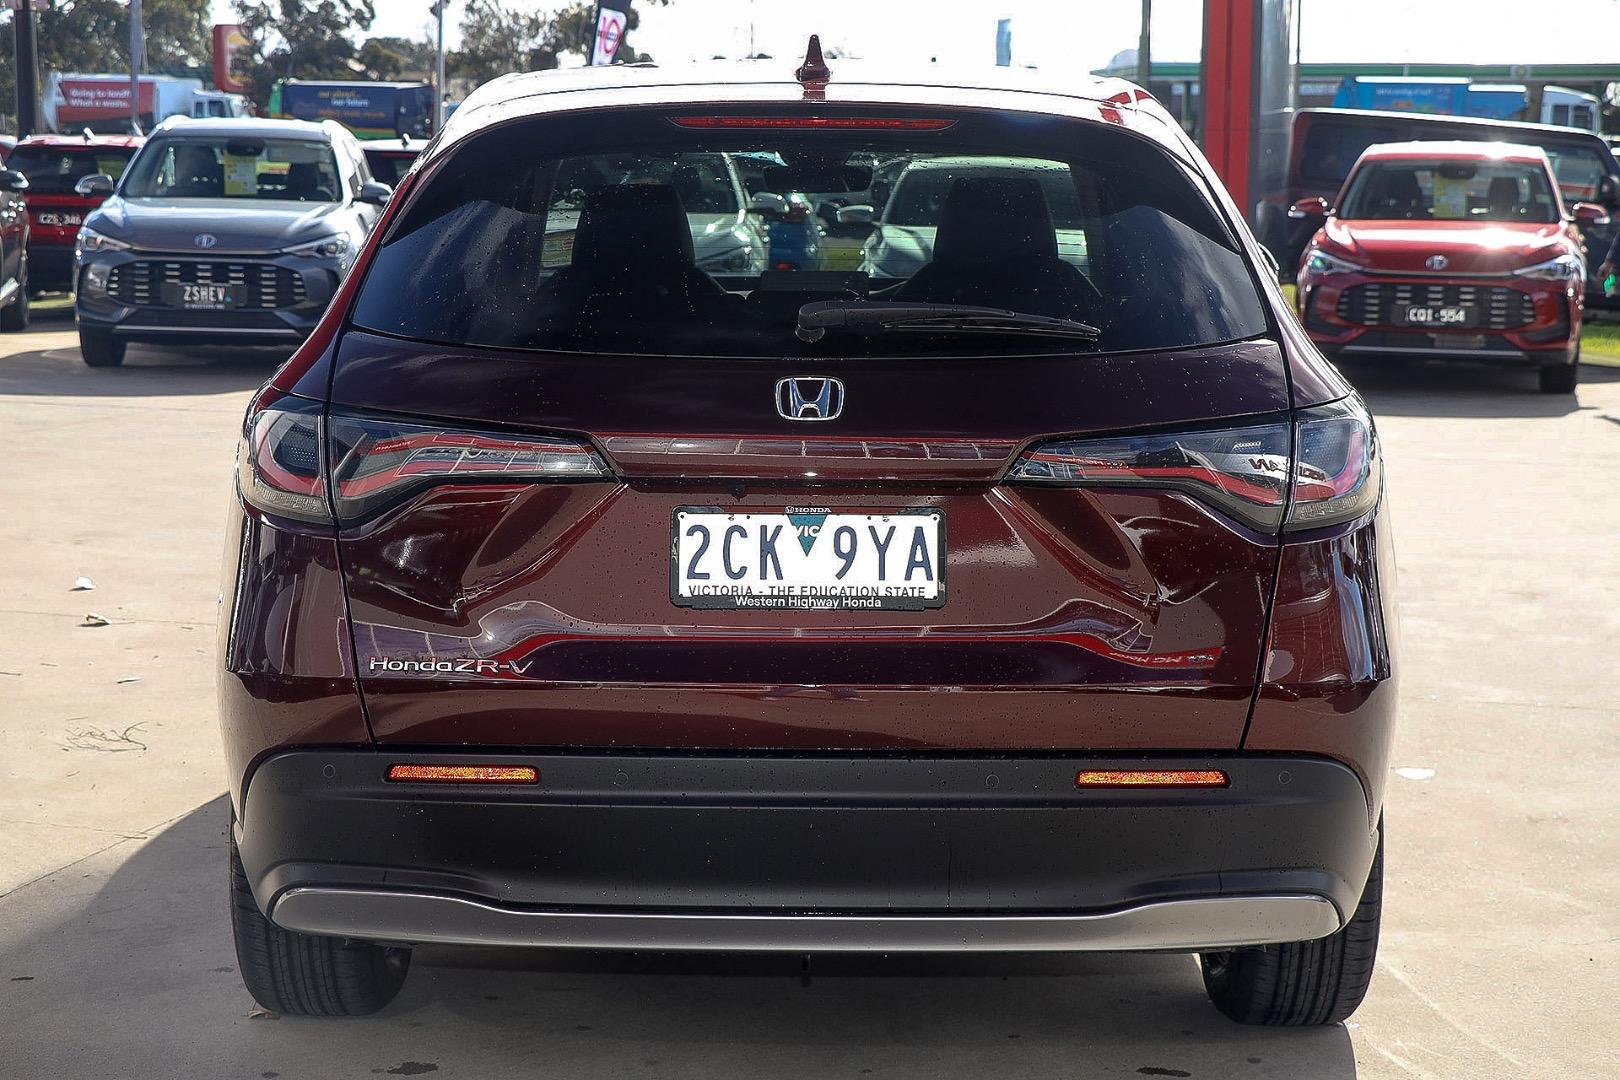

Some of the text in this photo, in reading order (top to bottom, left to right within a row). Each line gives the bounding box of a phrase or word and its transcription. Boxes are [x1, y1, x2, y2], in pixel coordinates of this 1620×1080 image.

[71, 99, 94, 108] What
[184, 286, 226, 302] ZSHEV
[796, 525, 821, 538] VIC
[686, 524, 934, 581] 2CK 9YA
[688, 585, 753, 596] VICTORIA
[769, 585, 795, 596] THE
[801, 585, 880, 597] EDUCATION
[884, 586, 926, 598] STATE
[735, 595, 882, 609] Western Highway Honda
